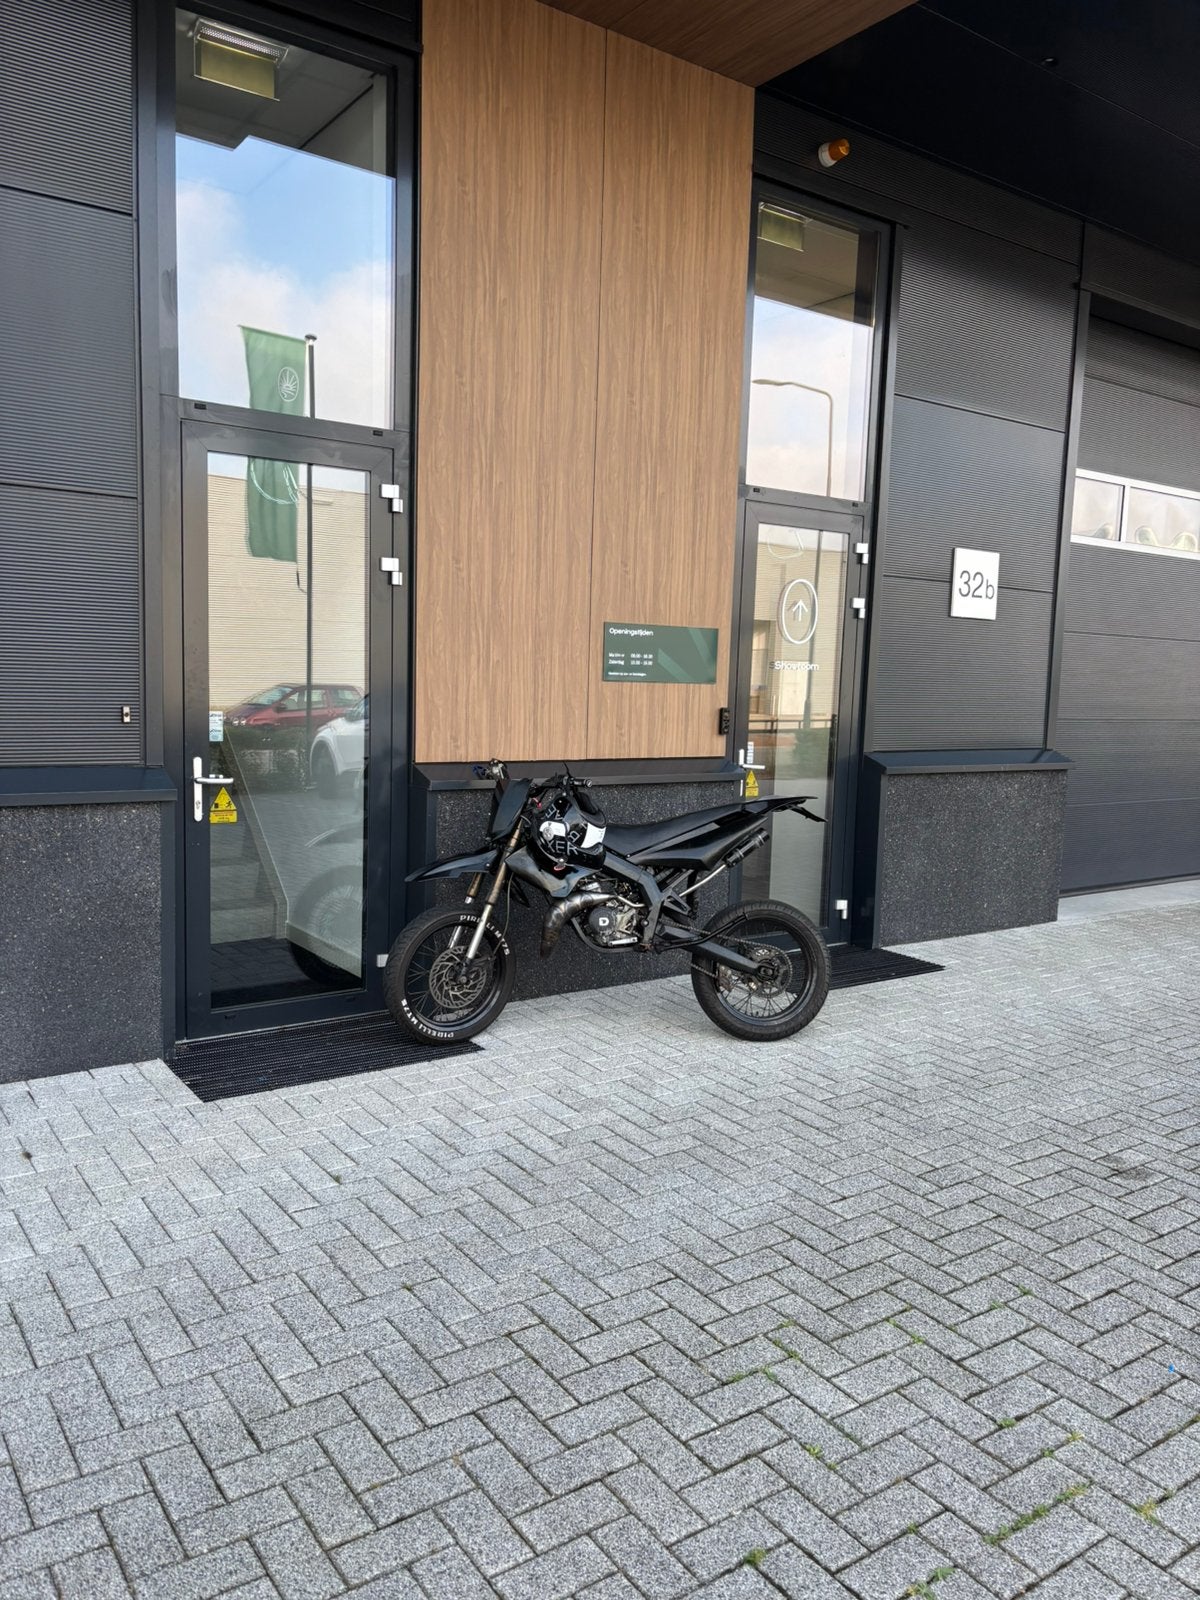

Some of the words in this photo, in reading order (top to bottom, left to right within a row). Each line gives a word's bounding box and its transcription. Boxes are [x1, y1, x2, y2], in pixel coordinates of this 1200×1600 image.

[959, 570, 995, 600] 32b
[608, 627, 654, 637] Openingstijden
[460, 914, 495, 931] PIRLI
[418, 1023, 454, 1038] PIRELLI
